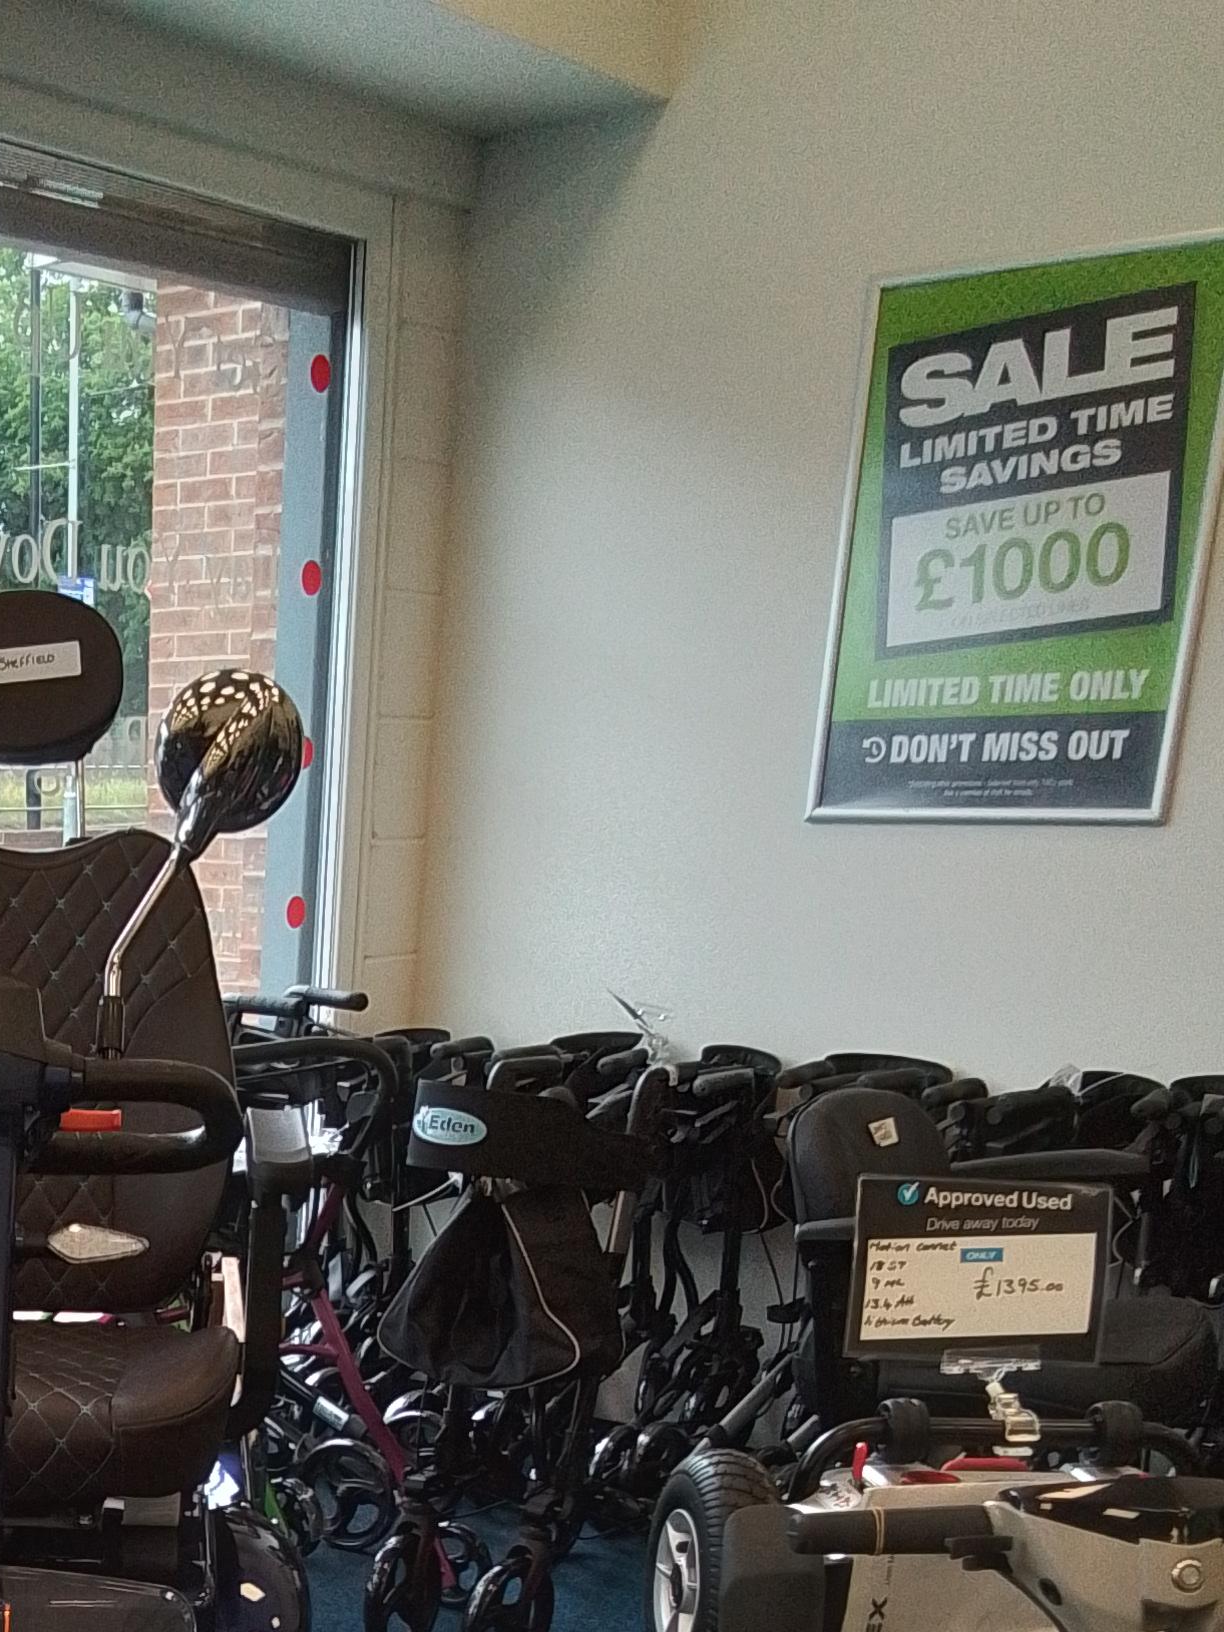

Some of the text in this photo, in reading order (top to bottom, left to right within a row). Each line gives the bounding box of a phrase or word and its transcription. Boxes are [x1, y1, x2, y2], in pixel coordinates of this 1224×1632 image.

[898, 304, 1179, 429] SALE
[899, 393, 1174, 469] LIMITED TIME
[939, 438, 1123, 495] SAVINGS
[944, 491, 1106, 541] SAVE UP TO
[913, 520, 1132, 613] £1000
[868, 668, 1151, 709] LIMITED TIME ONLY
[889, 729, 1130, 764] DON'T MISS OUT
[429, 1114, 475, 1133] Eden
[925, 1187, 1072, 1210] Approved Used
[926, 1216, 1039, 1231] Drive away today
[965, 1251, 997, 1261] ONLY
